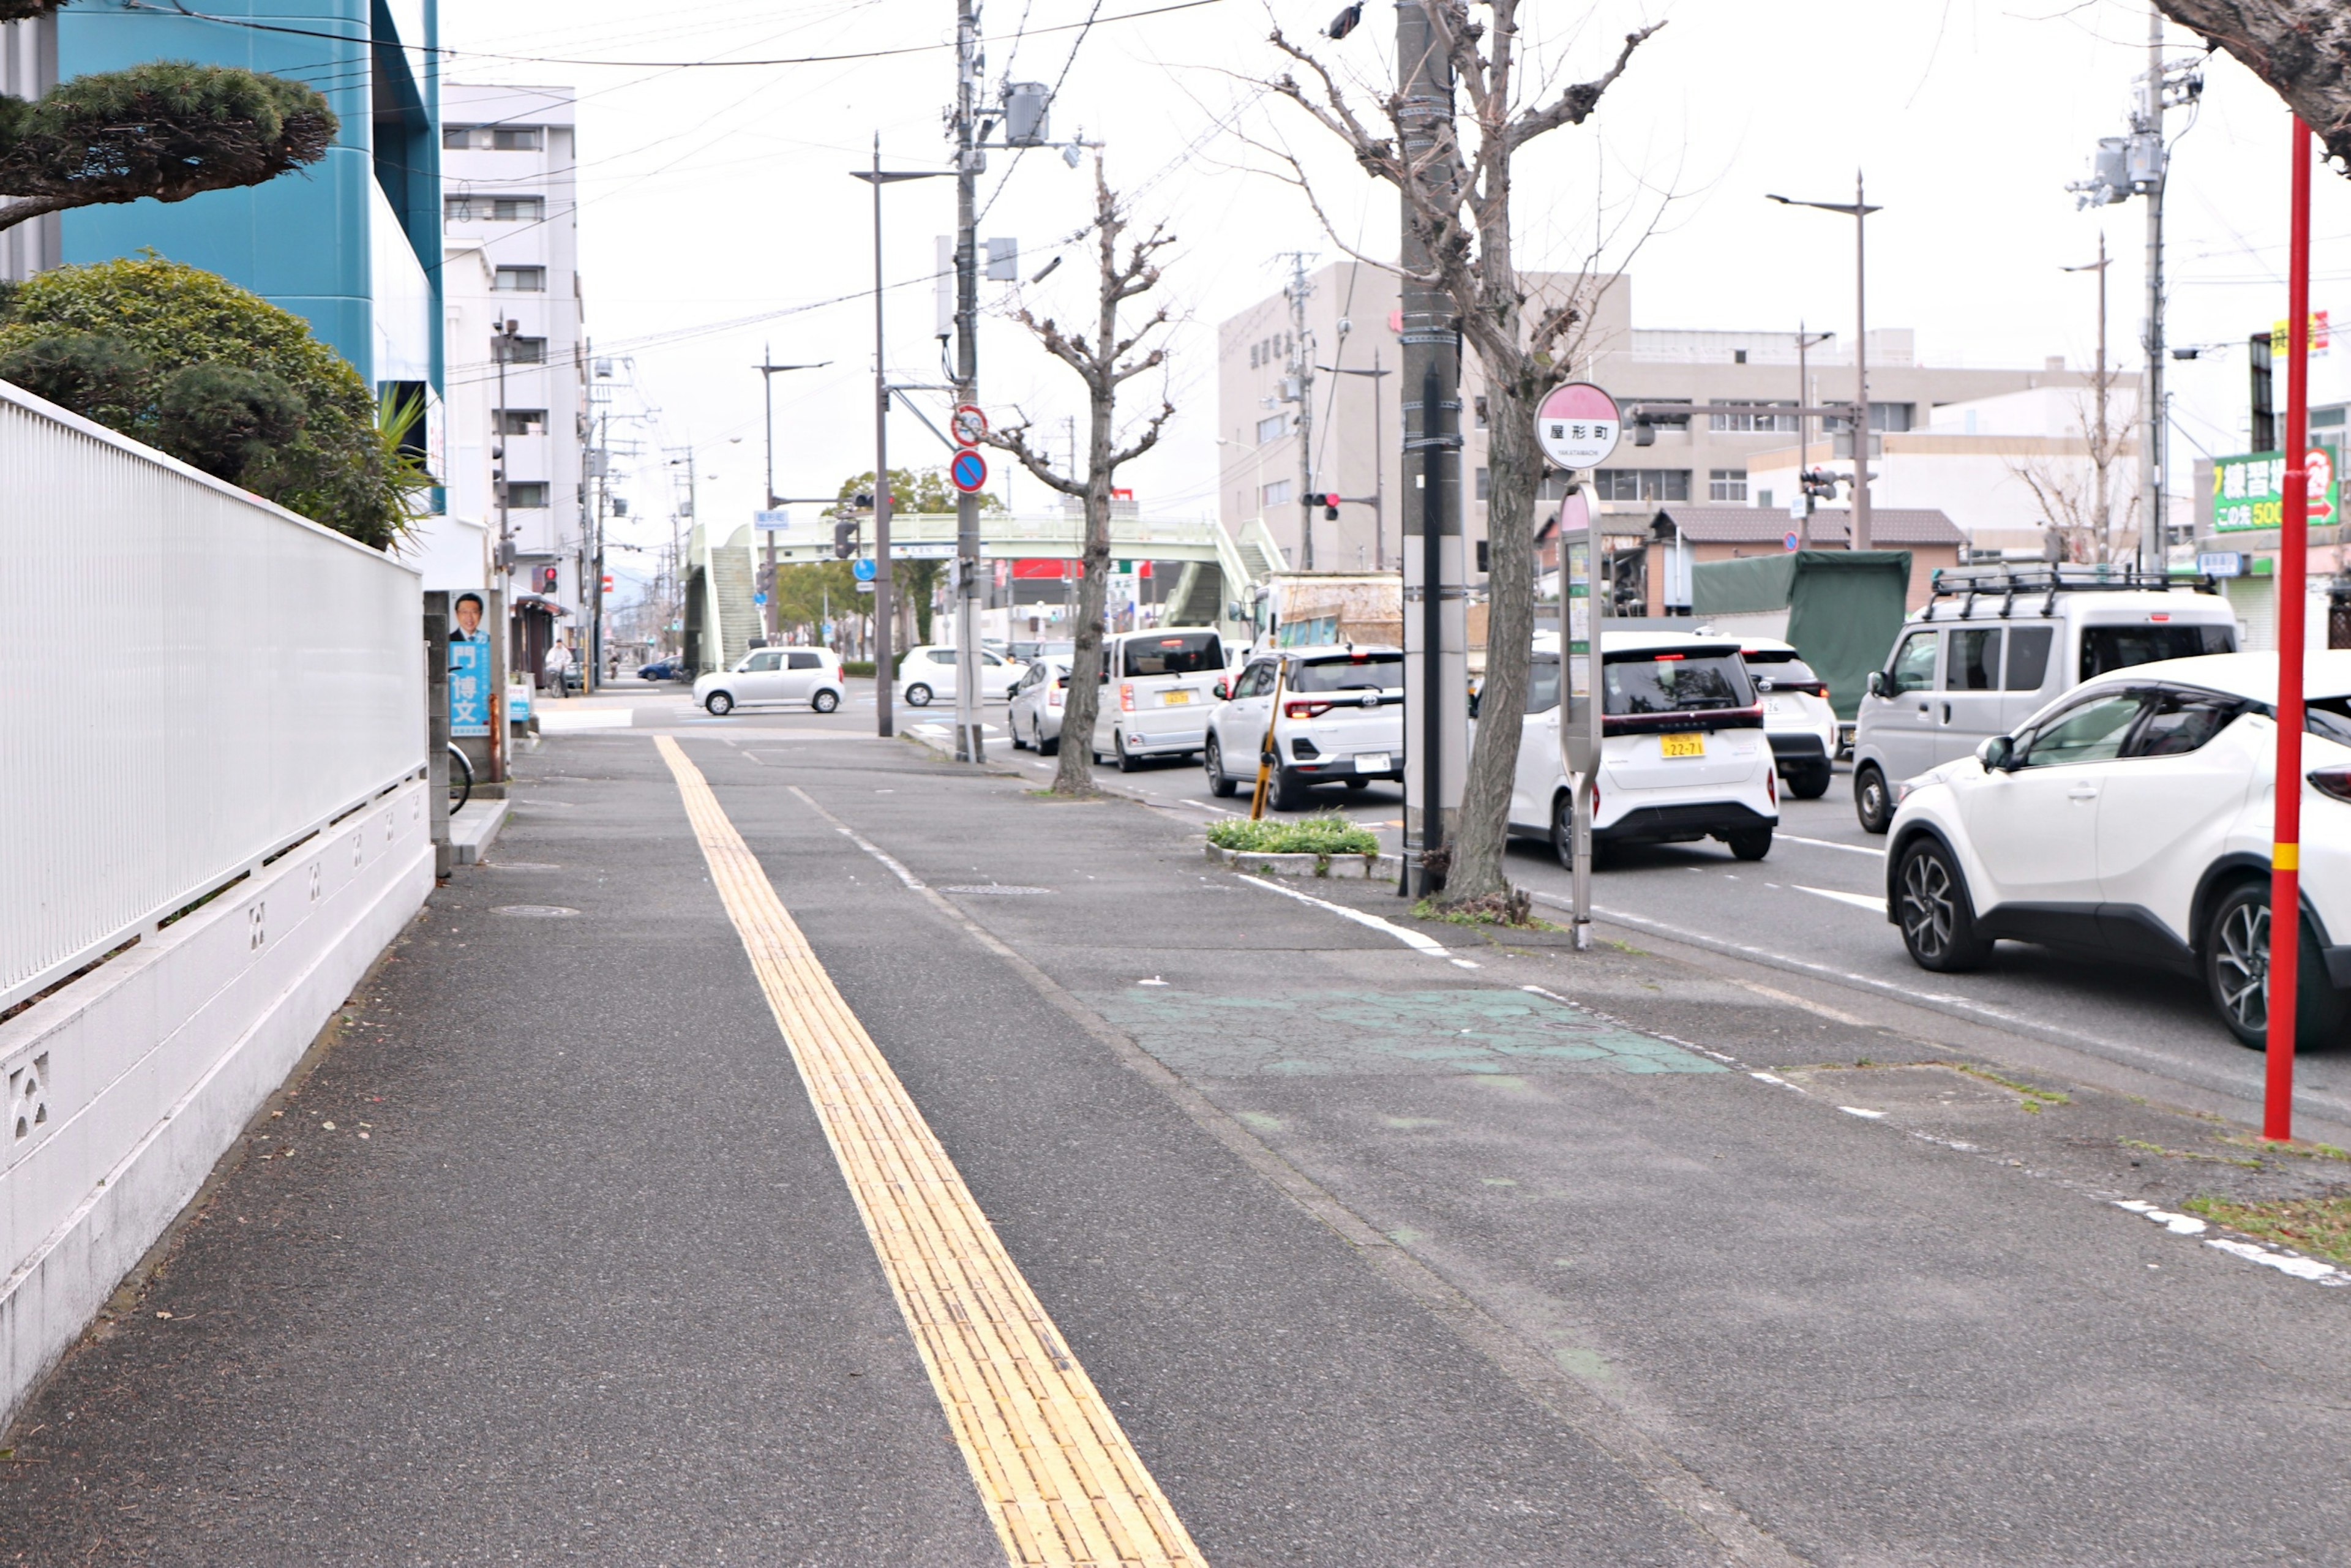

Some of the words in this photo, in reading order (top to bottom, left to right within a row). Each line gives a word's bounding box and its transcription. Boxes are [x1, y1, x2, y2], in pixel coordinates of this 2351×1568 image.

[1550, 425, 1608, 440] 屋形町
[1670, 742, 1702, 756] 22-71
